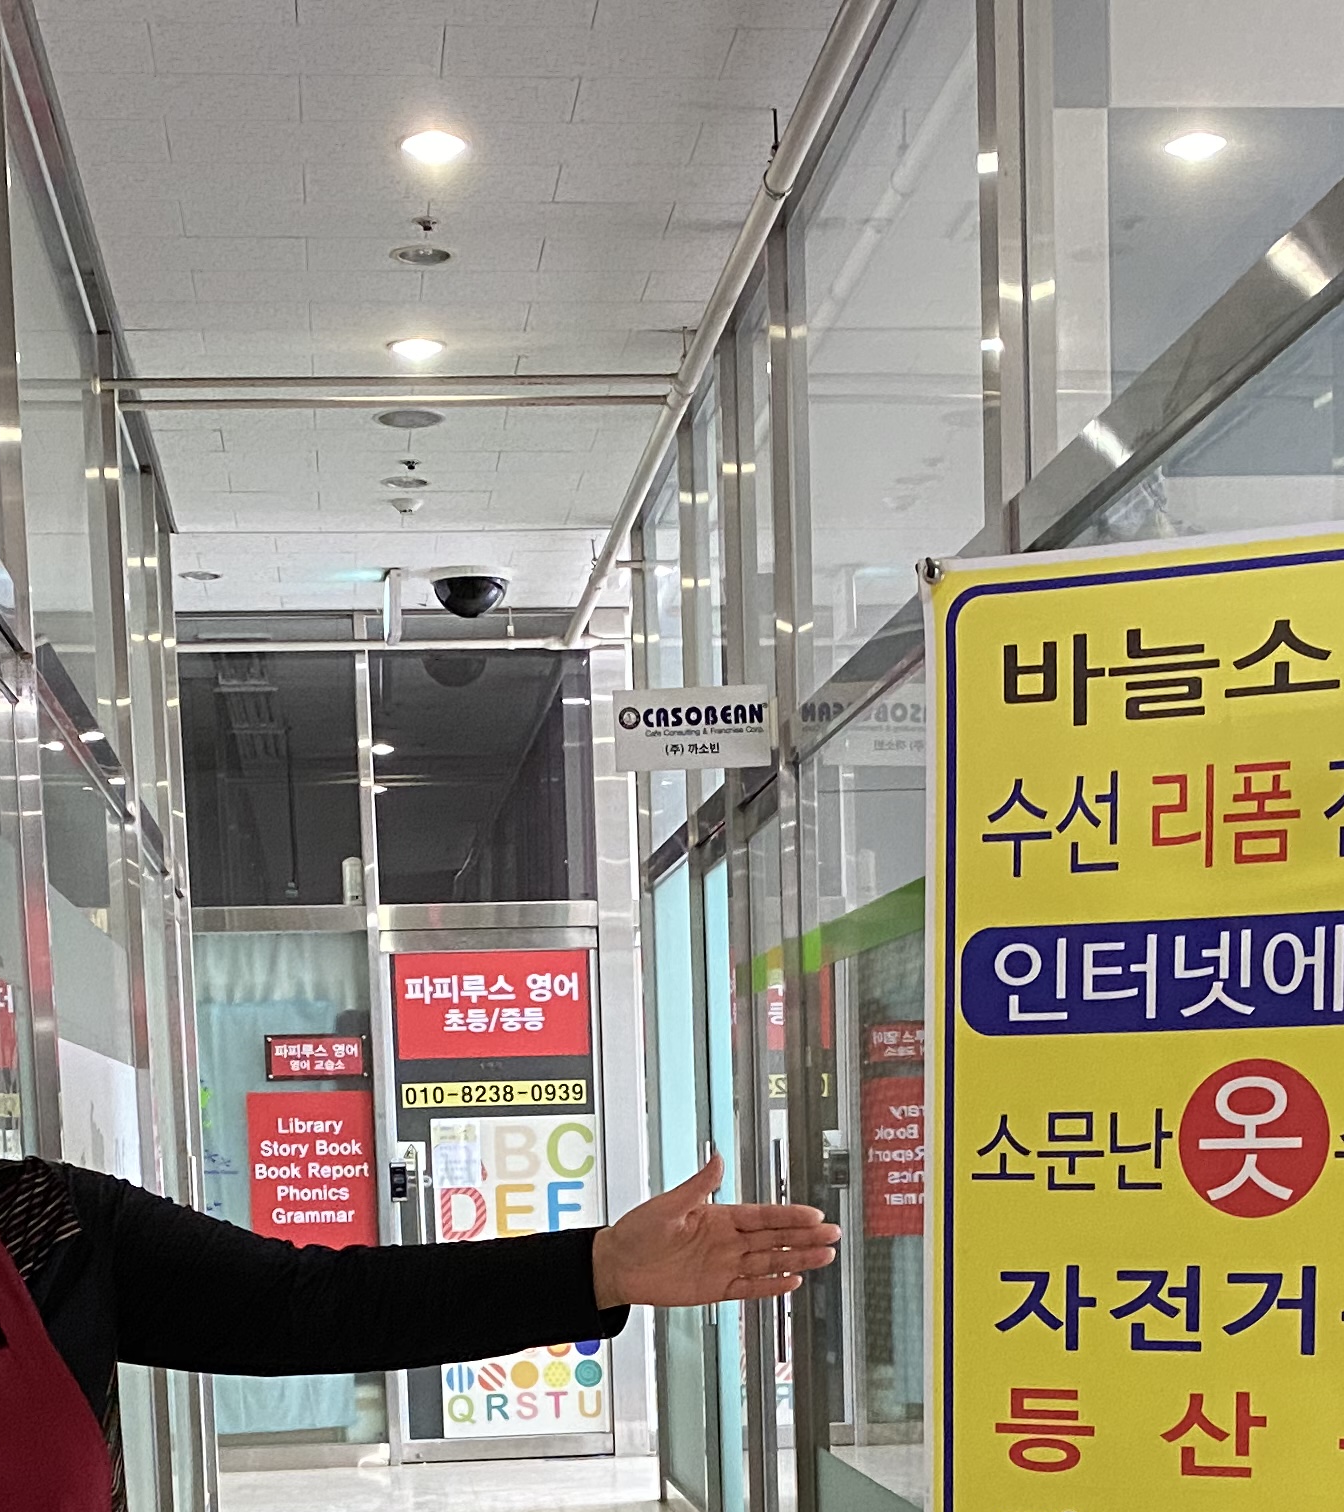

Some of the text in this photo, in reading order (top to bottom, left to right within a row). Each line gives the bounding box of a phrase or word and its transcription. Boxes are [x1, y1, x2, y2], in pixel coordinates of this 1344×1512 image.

[643, 703, 763, 728] CASOBEAN
[982, 770, 1120, 878] 수선
[1151, 760, 1301, 868] 리폼
[404, 972, 579, 1005] 파피루스 영어
[443, 1007, 545, 1033] 초등/중등
[274, 1043, 359, 1058] 파피루스 영어
[405, 1082, 584, 1105] 010-8238-0939
[277, 1117, 343, 1135] Library
[971, 1108, 1174, 1192] 소문난
[1198, 1075, 1303, 1201] 옷
[260, 1139, 362, 1158] Story Book
[494, 1124, 541, 1181] B
[547, 1122, 595, 1179] C
[255, 1162, 370, 1181] Book Report
[276, 1184, 350, 1202] Phonics
[272, 1207, 355, 1225] Grammar
[440, 1186, 487, 1241] D
[495, 1183, 536, 1236] E
